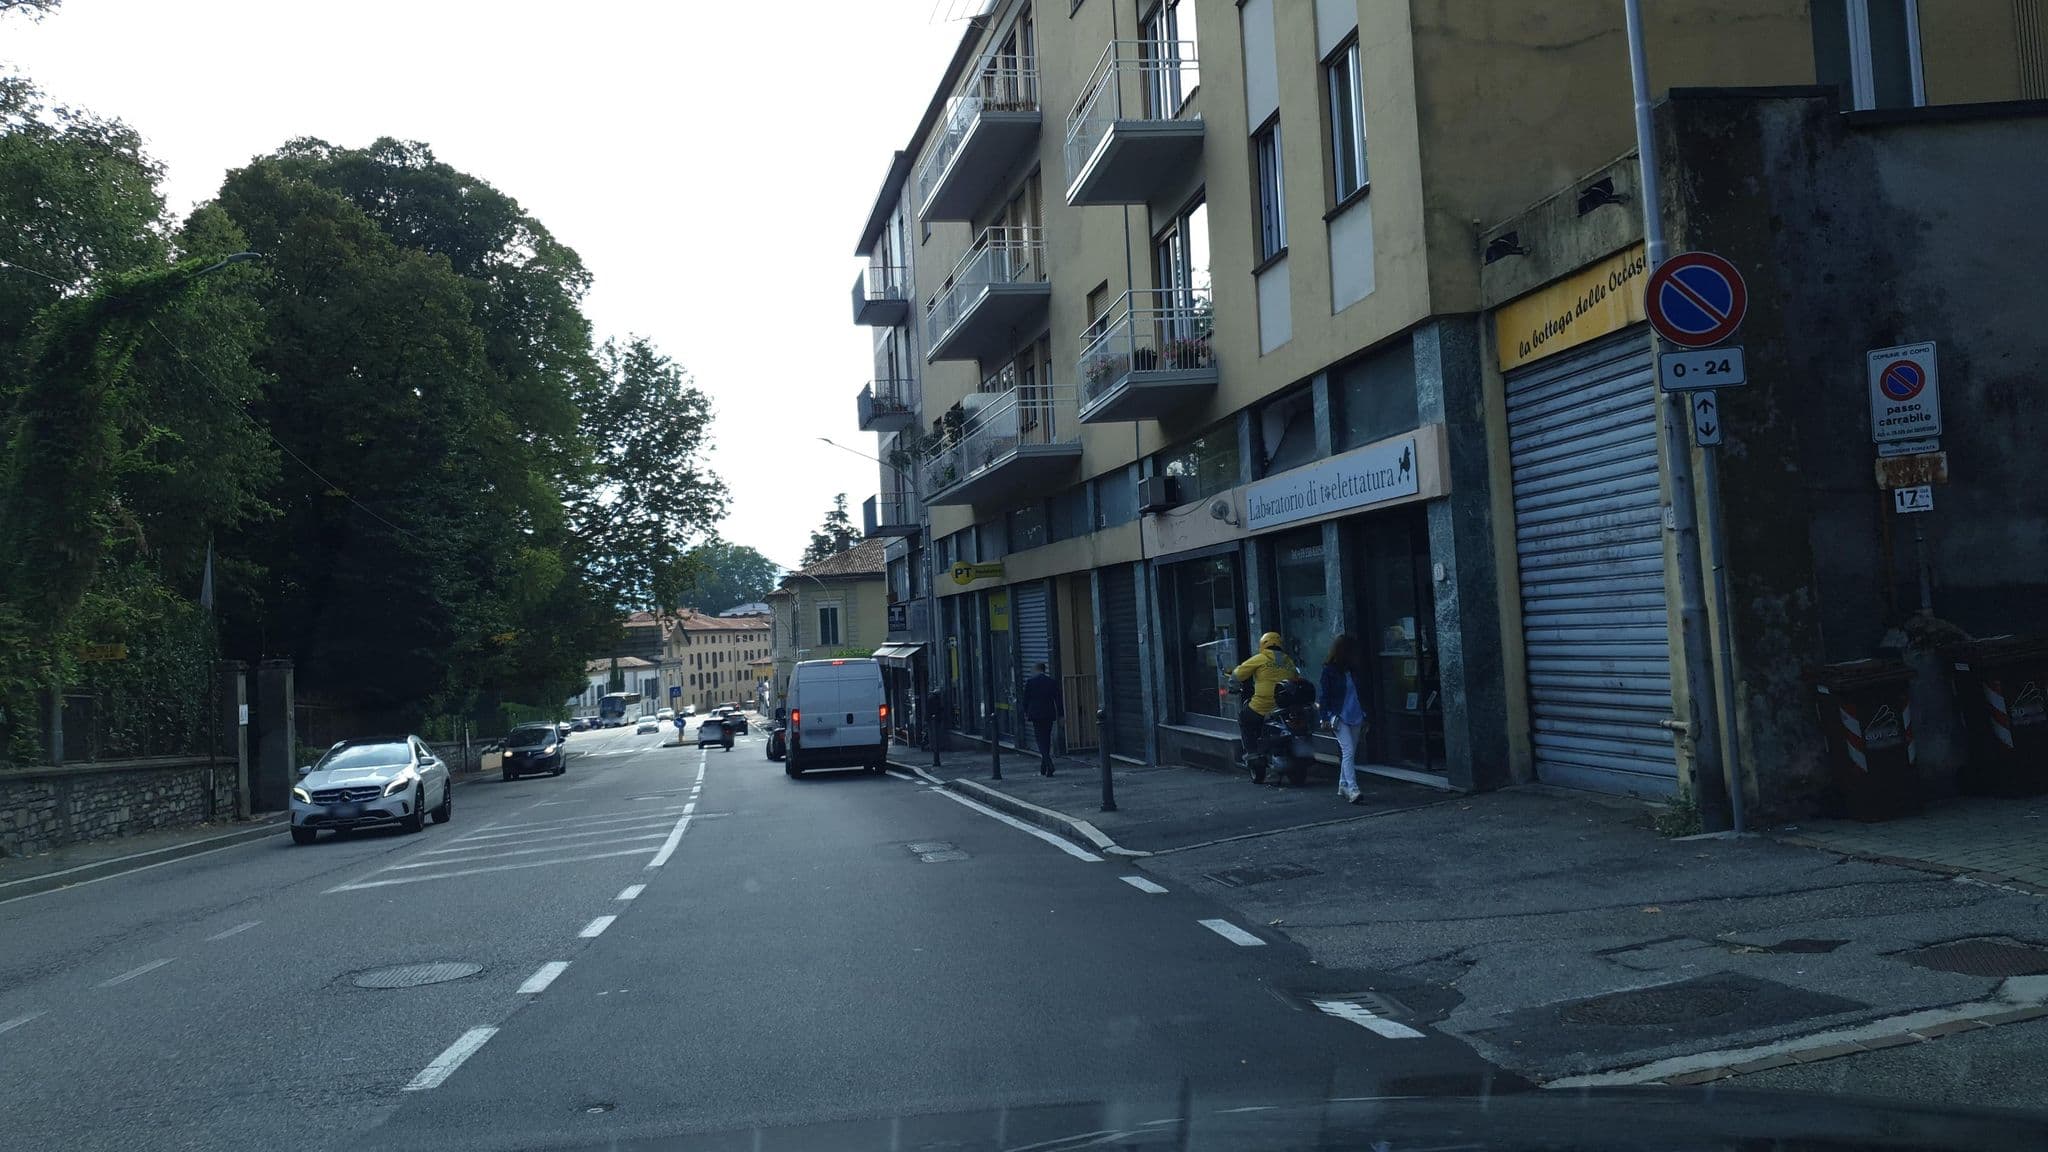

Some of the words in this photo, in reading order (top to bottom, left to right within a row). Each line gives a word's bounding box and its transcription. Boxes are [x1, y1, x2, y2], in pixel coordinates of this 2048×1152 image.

[1519, 341, 1531, 359] la
[1532, 310, 1574, 349] bottega
[1575, 284, 1606, 319] delle
[1909, 347, 1930, 355] COMO
[1704, 359, 1731, 375] 24
[1887, 403, 1921, 416] passo
[1879, 412, 1931, 427] carrabile
[1248, 486, 1304, 521] Laboratorio
[1306, 480, 1317, 508] di
[1320, 467, 1396, 502] toelettatura
[1897, 489, 1918, 506] 17
[955, 567, 971, 578] PT
